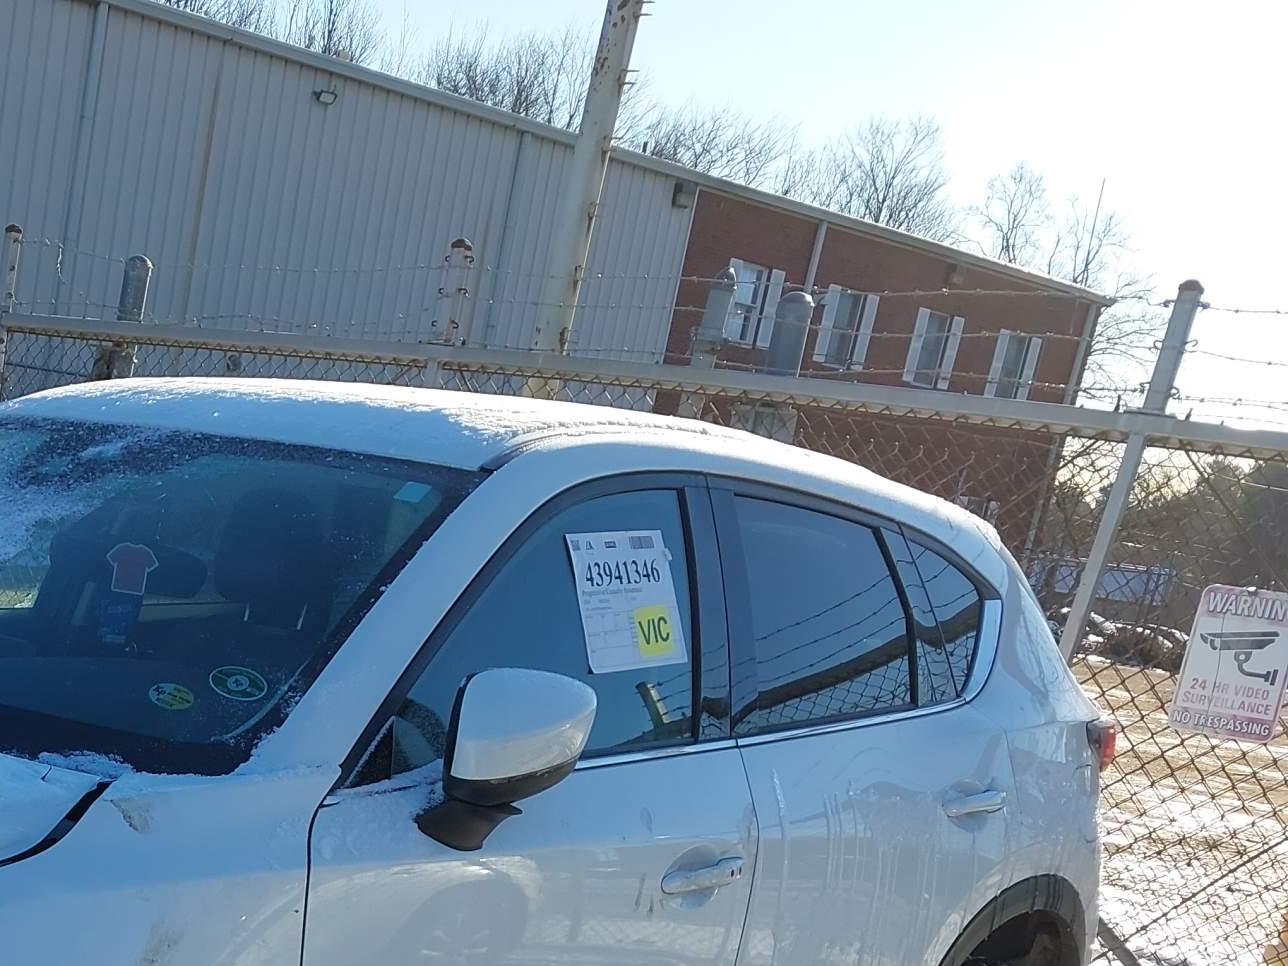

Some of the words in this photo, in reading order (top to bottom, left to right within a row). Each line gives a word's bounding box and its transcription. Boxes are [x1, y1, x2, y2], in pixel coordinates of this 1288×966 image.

[585, 558, 661, 587] 43941346
[638, 615, 670, 645] VIC
[1190, 677, 1207, 691] 24
[1214, 681, 1229, 695] HR
[1234, 683, 1270, 700] VIDEO
[1182, 691, 1272, 715] SURVEILLANCE
[1173, 709, 1191, 723] NO
[1193, 712, 1270, 736] TRESPASSING
